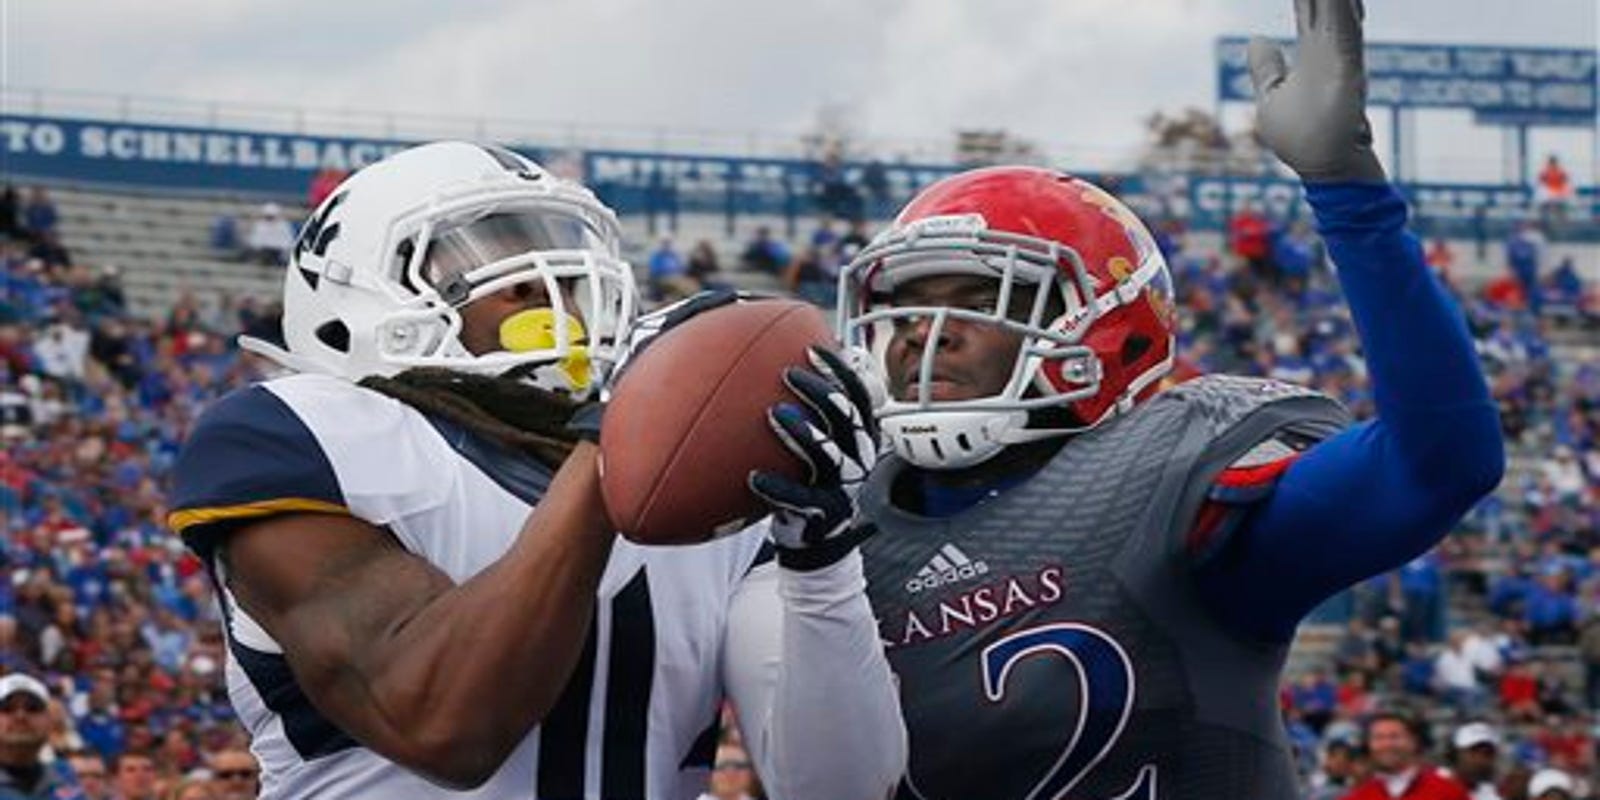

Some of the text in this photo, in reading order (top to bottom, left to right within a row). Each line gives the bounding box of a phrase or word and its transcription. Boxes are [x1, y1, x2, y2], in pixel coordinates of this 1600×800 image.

[0, 121, 64, 155] TO
[905, 560, 989, 593] adidas
[877, 567, 1065, 647] ANSAS
